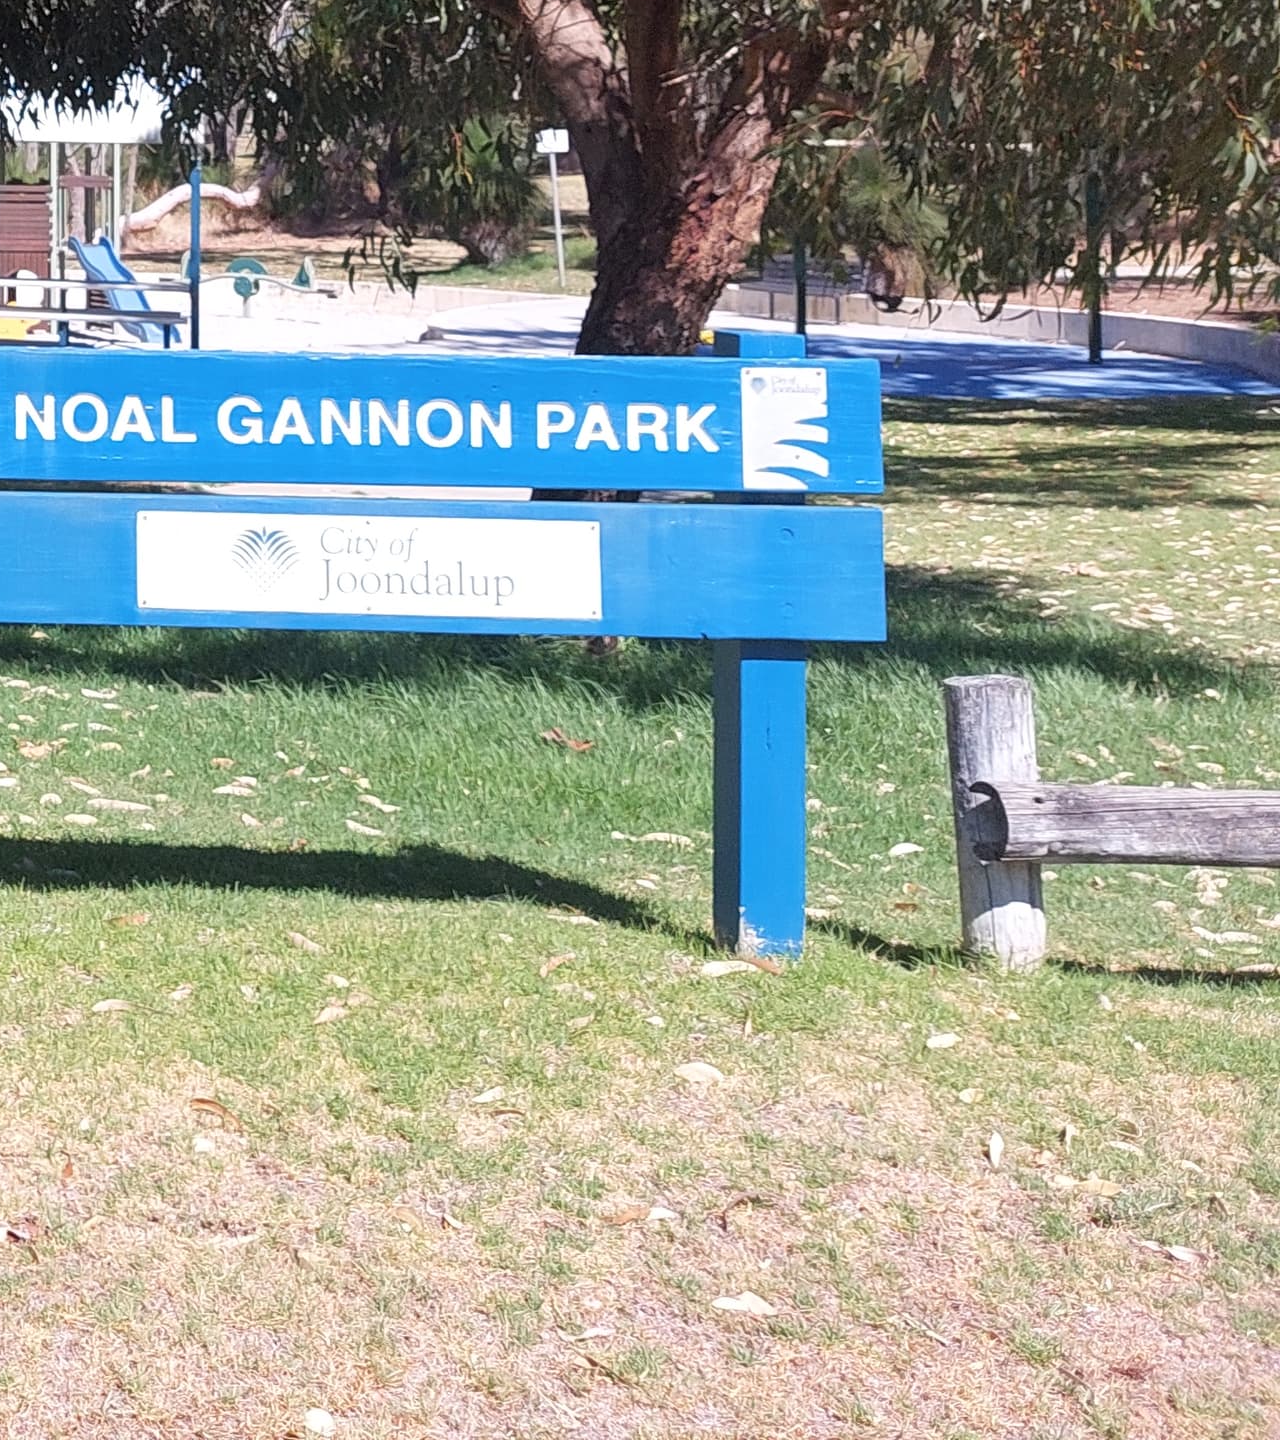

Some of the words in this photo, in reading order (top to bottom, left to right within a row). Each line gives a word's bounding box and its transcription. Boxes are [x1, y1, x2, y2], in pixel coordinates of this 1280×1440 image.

[14, 393, 198, 443] NOAL
[216, 395, 513, 449] GANNON
[536, 402, 720, 453] PARK
[320, 526, 378, 561] City
[389, 527, 419, 562] of
[318, 558, 515, 607] Joondalup
